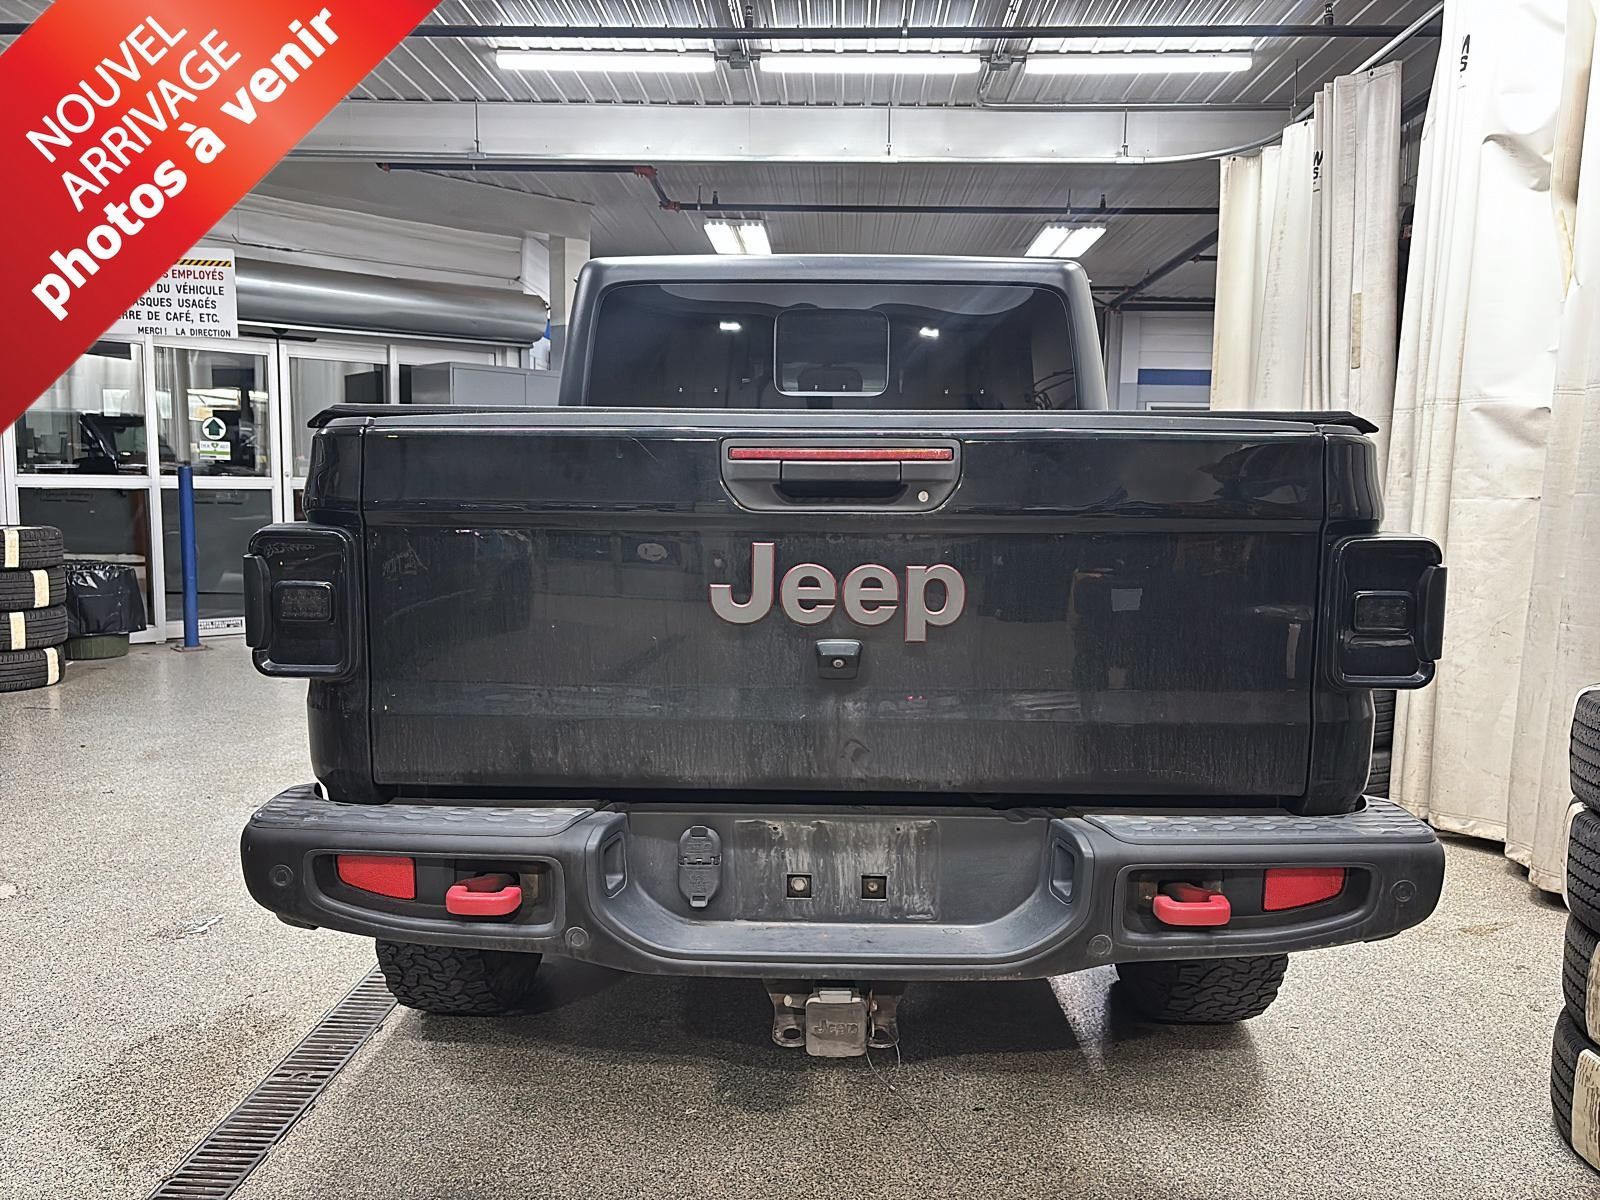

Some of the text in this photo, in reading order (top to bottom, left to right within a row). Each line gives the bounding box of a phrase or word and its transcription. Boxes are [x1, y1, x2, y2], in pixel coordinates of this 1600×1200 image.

[171, 269, 224, 281] EMPLOYÉS
[156, 283, 170, 293] DU
[176, 282, 225, 296] VÉHICULE
[177, 297, 217, 309] USAGÉS
[147, 311, 160, 321] DE
[165, 311, 194, 324] CAFÉ,
[200, 313, 220, 323] ETC.
[175, 327, 186, 336] LA
[190, 328, 231, 338] DIRECTION
[708, 541, 967, 643] Jeep
